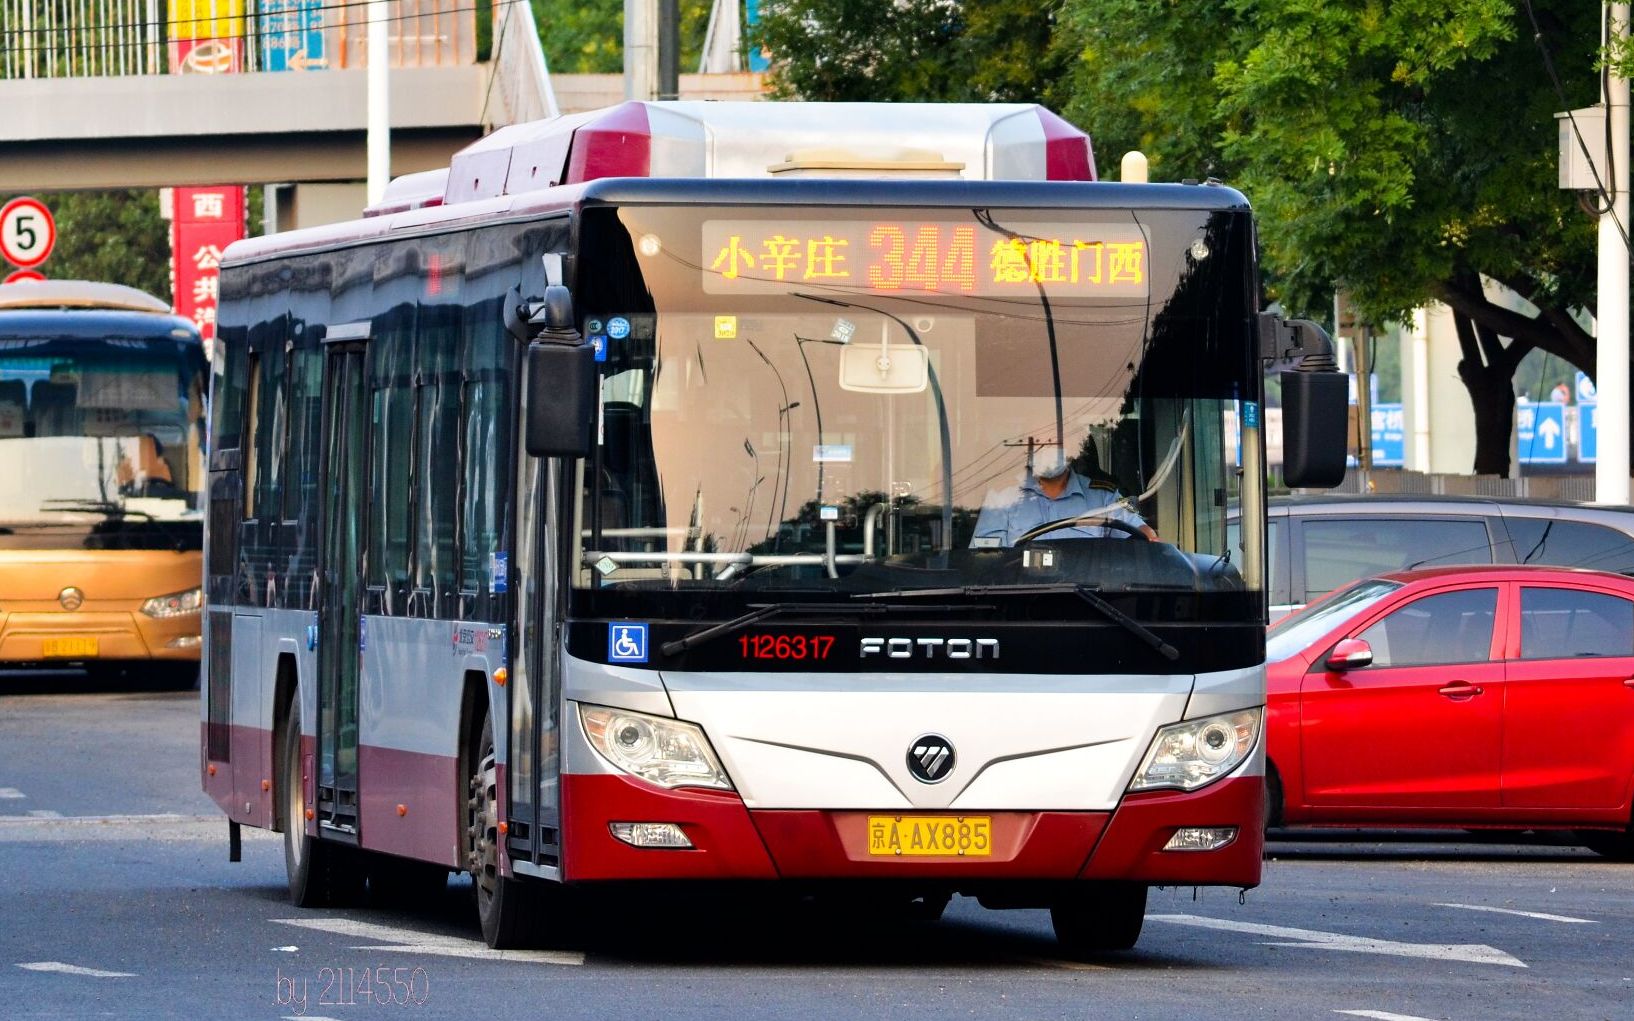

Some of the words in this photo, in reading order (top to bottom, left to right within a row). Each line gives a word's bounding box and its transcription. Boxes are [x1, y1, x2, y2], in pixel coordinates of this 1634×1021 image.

[191, 193, 225, 219] 西
[16, 216, 36, 250] 5
[711, 235, 850, 280] 小辛庄
[868, 223, 976, 291] 344
[990, 238, 1144, 285] 德胜门西
[738, 634, 834, 660] 1126317
[859, 637, 1000, 659] FOTON
